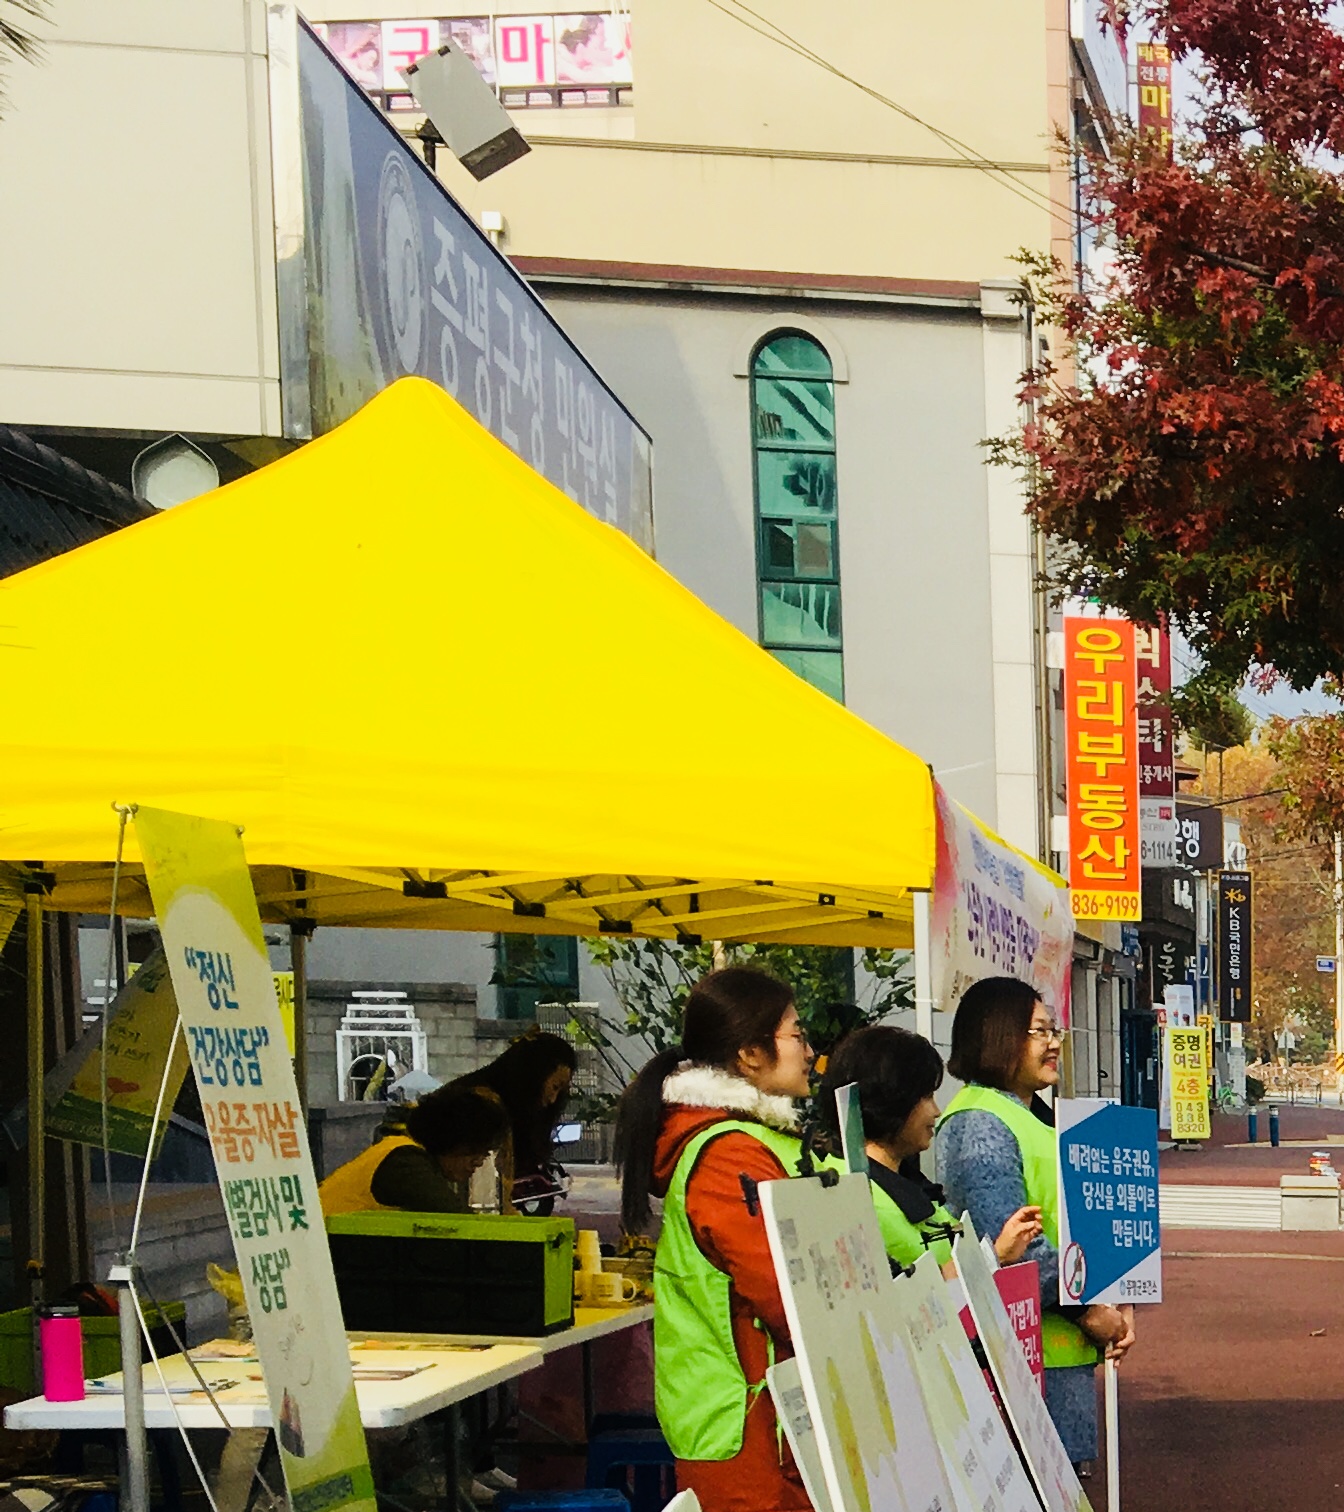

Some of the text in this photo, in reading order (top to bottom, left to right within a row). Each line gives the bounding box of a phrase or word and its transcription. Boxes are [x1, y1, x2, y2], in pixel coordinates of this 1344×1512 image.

[501, 23, 550, 84] 마
[1074, 628, 1131, 880] 우리부동산
[1072, 893, 1138, 917] 836-9199
[1173, 1035, 1201, 1051] 증명
[1174, 1053, 1201, 1069] 여권
[1177, 1079, 1200, 1094] 4층
[1069, 1144, 1110, 1173] 배려없는
[279, 1175, 309, 1231] 및
[1082, 1182, 1156, 1213] 당신을 외톨이로
[1112, 1219, 1157, 1248] 만듭니다.
